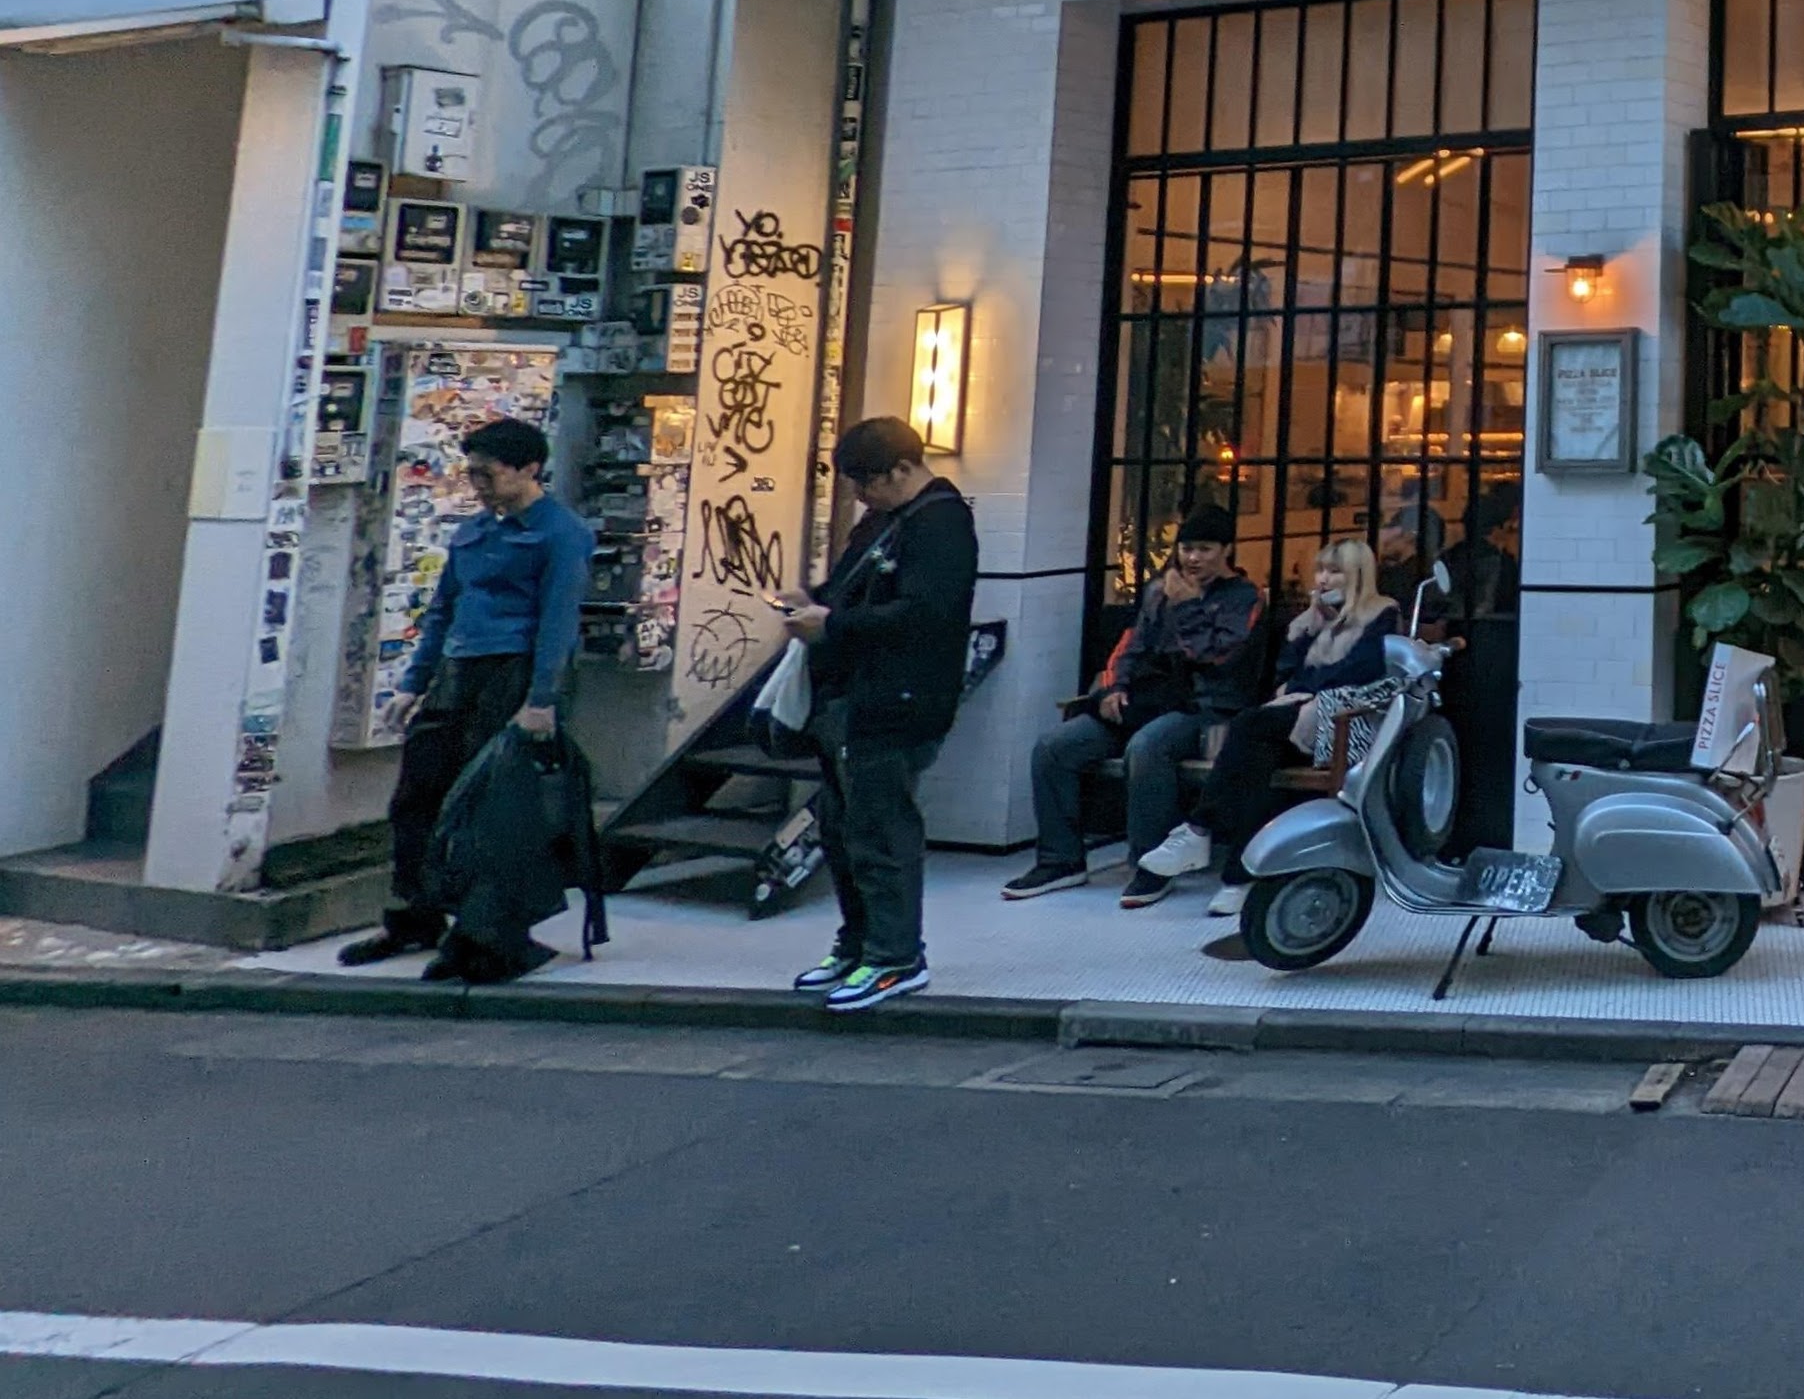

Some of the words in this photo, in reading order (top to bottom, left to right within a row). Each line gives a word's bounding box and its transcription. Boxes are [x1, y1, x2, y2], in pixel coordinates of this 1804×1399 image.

[689, 172, 711, 183] JS
[677, 287, 699, 298] JS
[569, 297, 592, 309] JS
[1697, 706, 1717, 749] PIZZA
[1707, 662, 1728, 702] SLICE
